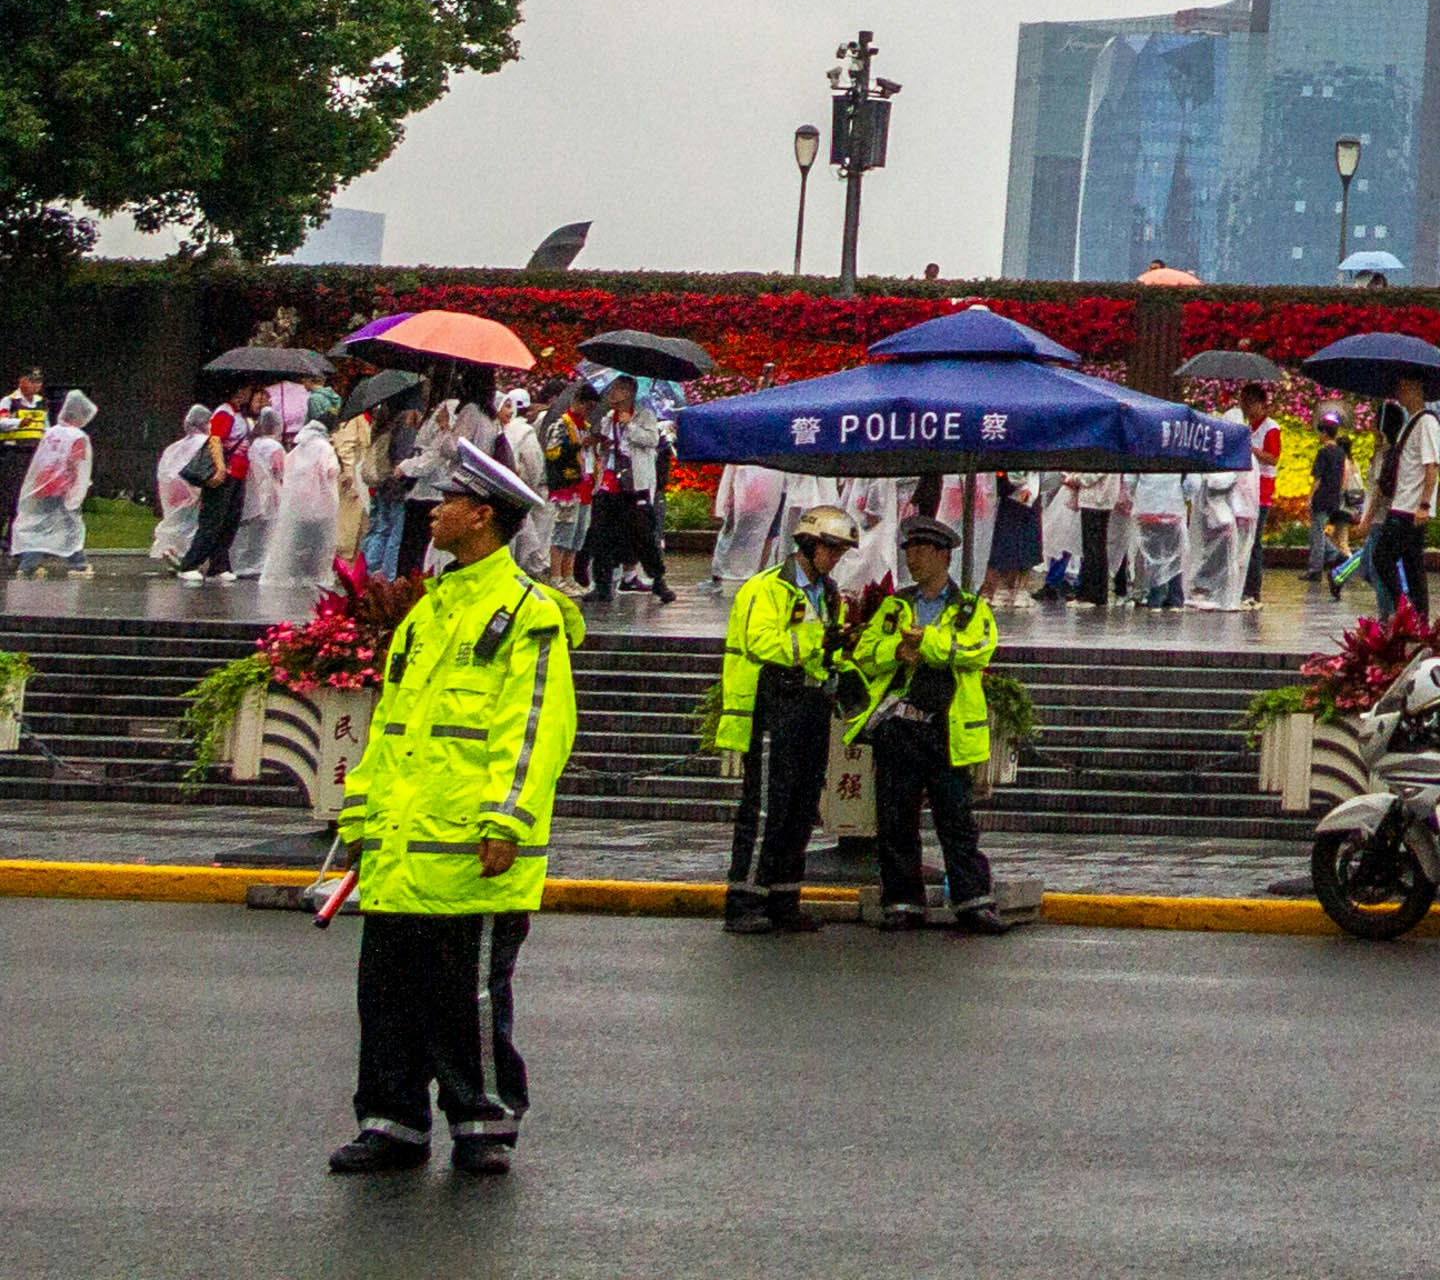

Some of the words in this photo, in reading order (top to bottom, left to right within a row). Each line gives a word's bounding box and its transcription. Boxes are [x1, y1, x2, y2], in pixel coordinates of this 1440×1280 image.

[792, 417, 821, 445] 警
[841, 412, 962, 443] POLICE
[981, 413, 1008, 440] 察
